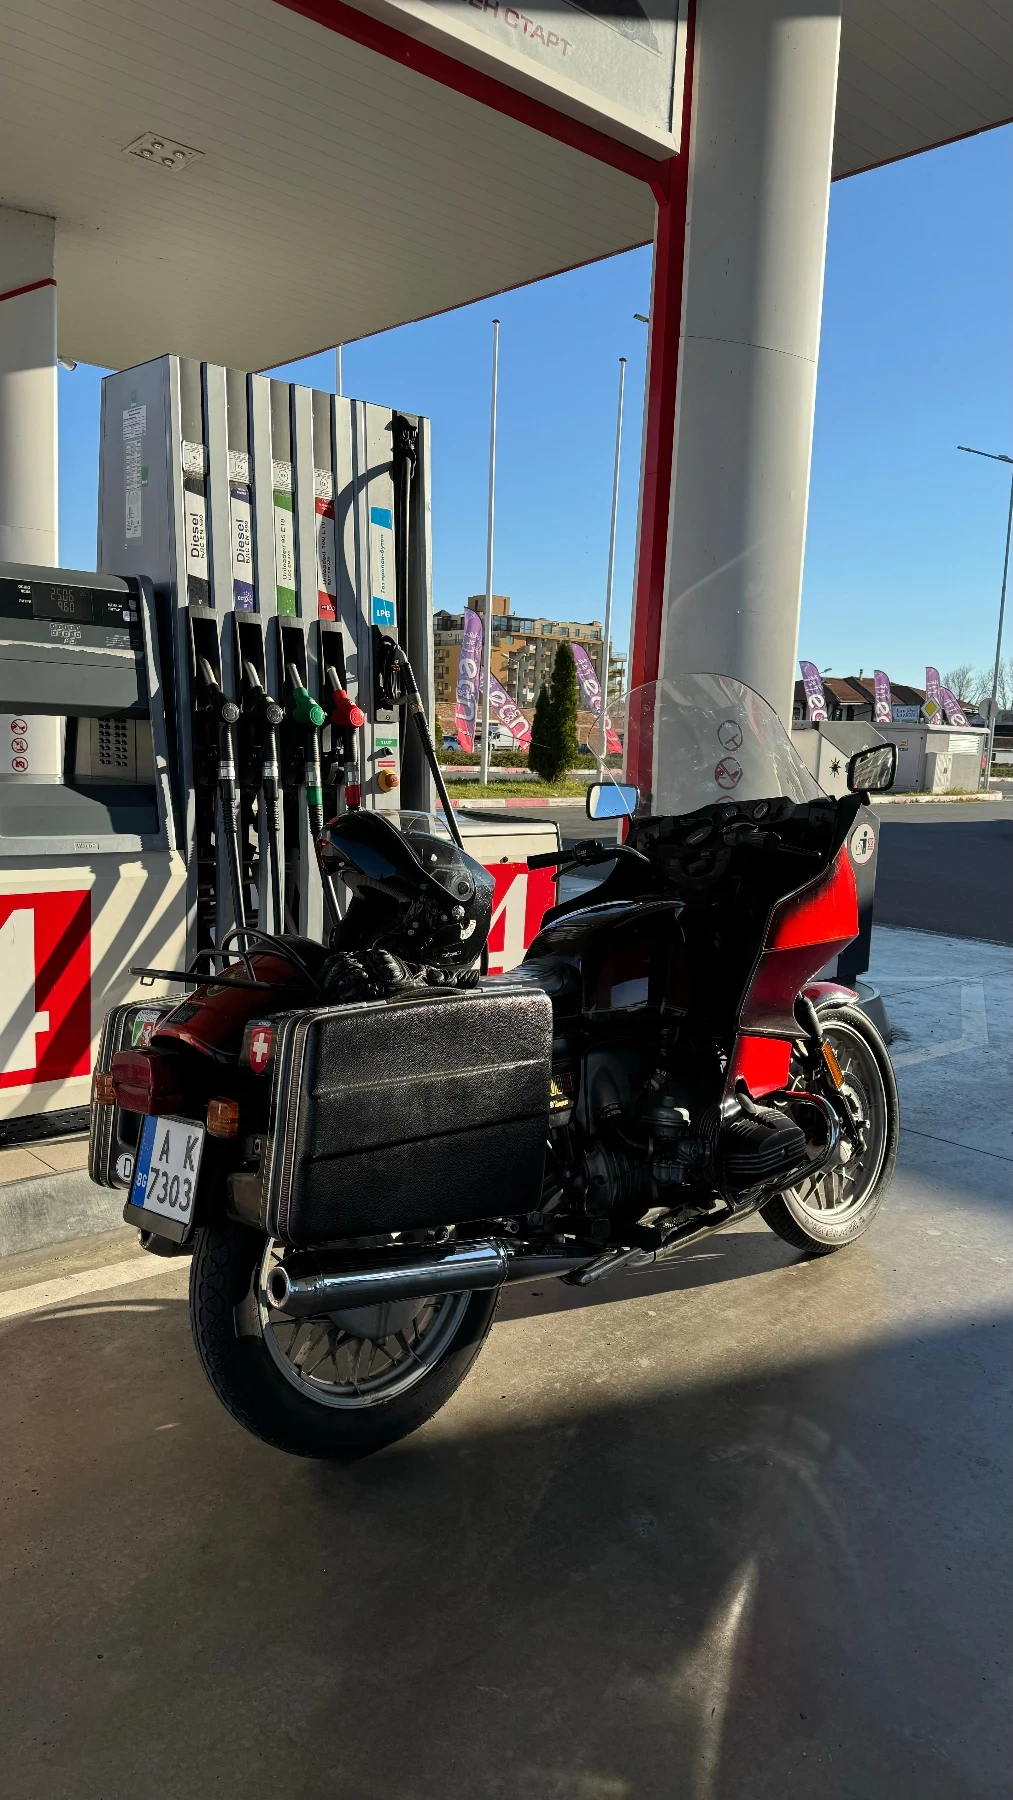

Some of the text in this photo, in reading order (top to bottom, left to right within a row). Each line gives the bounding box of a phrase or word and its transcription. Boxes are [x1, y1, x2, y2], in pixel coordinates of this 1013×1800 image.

[461, 0, 573, 56] ЕН СТАРТ
[189, 512, 200, 558] Diesel
[236, 519, 245, 563] Diesel
[376, 609, 391, 618] LPG
[123, 1158, 131, 1177] D
[159, 1129, 199, 1172] A K
[136, 1172, 149, 1189] BG
[146, 1167, 193, 1212] 7303
